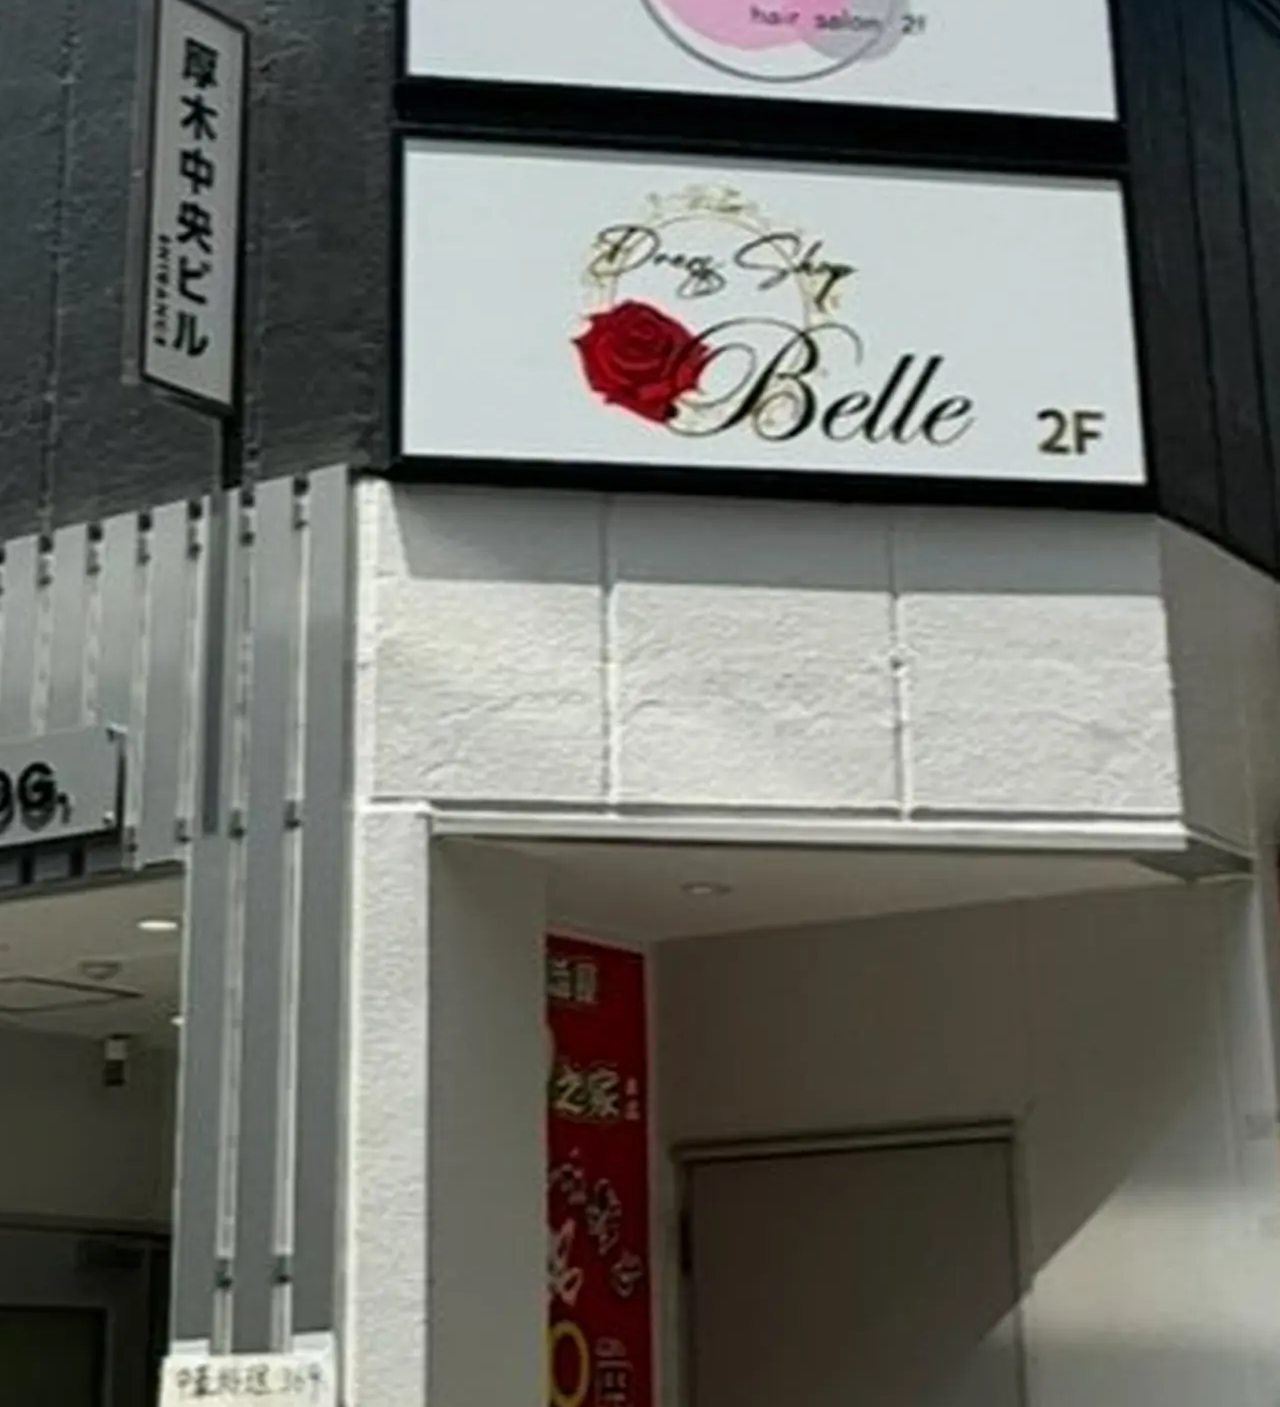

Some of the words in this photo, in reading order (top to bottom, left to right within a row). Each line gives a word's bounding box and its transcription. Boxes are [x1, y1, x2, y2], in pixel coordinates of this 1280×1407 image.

[172, 36, 220, 358] 厚木中央ビル
[664, 316, 976, 448] Belle
[1036, 408, 1105, 457] 2F
